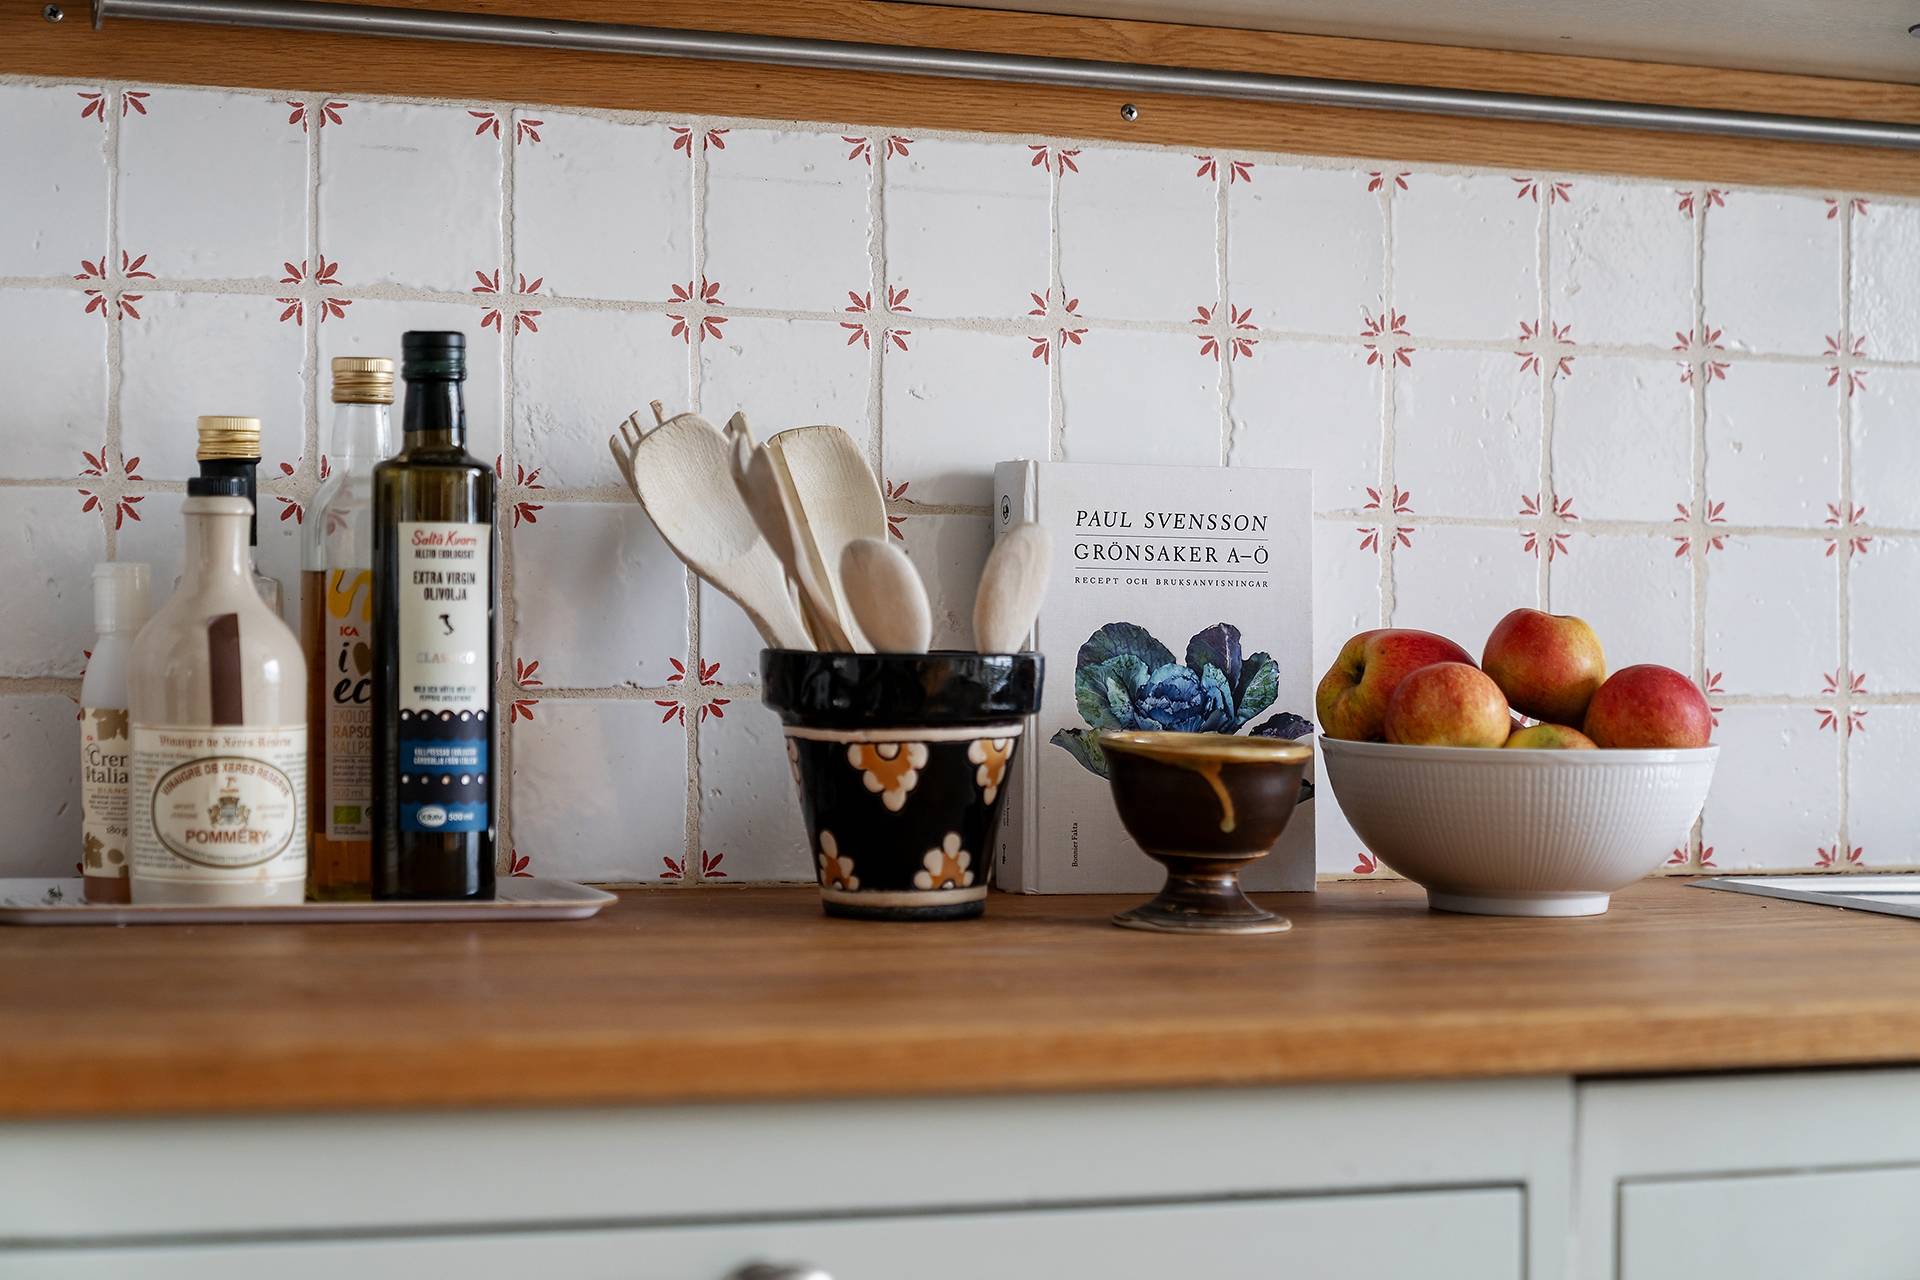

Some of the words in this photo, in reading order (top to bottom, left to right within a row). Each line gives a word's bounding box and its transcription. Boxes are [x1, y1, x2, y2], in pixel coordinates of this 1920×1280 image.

[1075, 510, 1132, 528] PAUL
[1144, 511, 1268, 532] SVENSSON
[1074, 541, 1218, 563] GRÖNSAKER
[413, 571, 443, 585] EXTRA
[446, 572, 476, 585] VIRGIN
[1074, 577, 1120, 585] RECEPT
[1155, 578, 1269, 588] BRUKSANVISNINGAR
[423, 587, 467, 601] OLIVOLJA
[339, 625, 360, 637] ICA
[333, 678, 371, 704] ec
[333, 709, 371, 722] EKOLOG
[333, 725, 371, 738] RAPSO
[333, 740, 371, 754] KALLPR
[86, 766, 129, 783] Italia
[204, 762, 219, 774] DE
[185, 825, 268, 844] POMMÉRY
[1071, 841, 1079, 868] Bonnier
